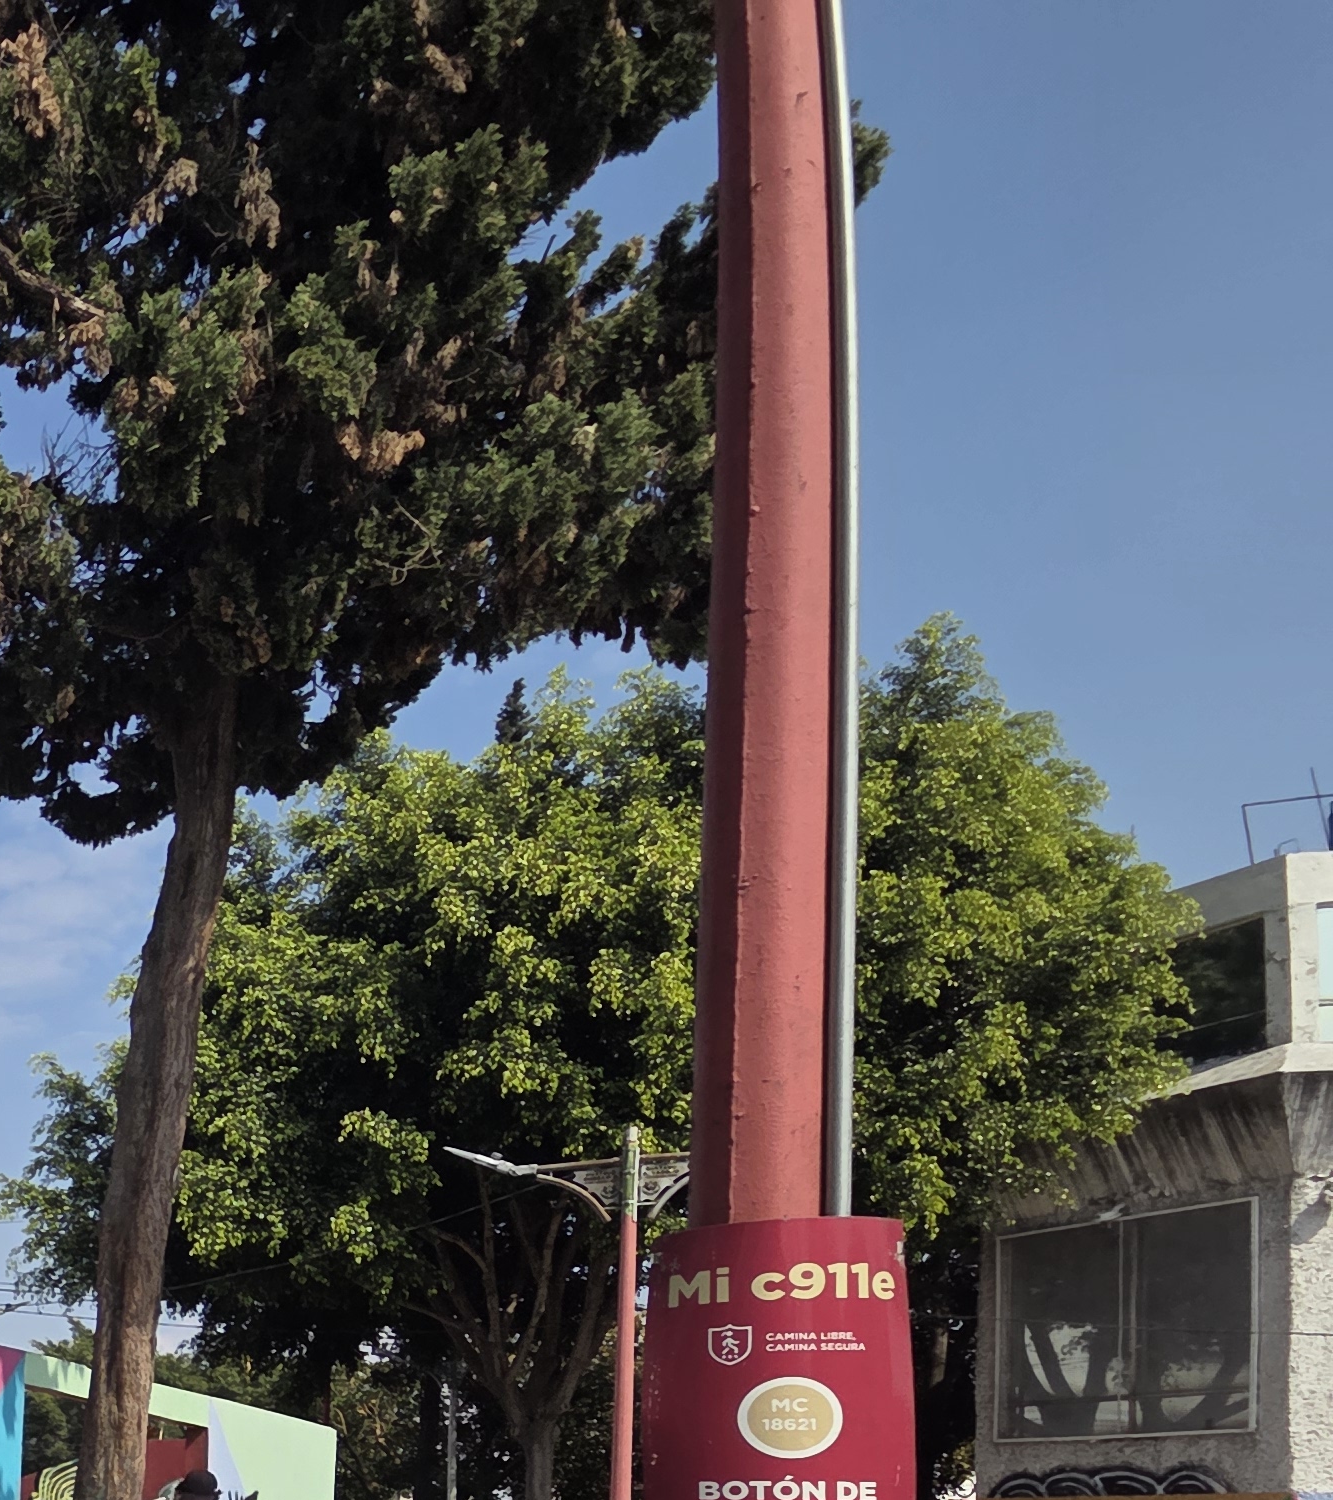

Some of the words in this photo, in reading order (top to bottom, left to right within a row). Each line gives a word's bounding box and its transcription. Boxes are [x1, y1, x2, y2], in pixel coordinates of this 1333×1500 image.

[668, 1266, 730, 1308] Mi
[751, 1262, 896, 1300] c911e
[765, 1332, 818, 1341] CAMINA
[765, 1343, 818, 1352] CAMINA
[820, 1342, 866, 1351] SEGURA
[770, 1397, 809, 1413] MC
[761, 1417, 817, 1431] 18621
[698, 1475, 826, 1500] BOTÓN
